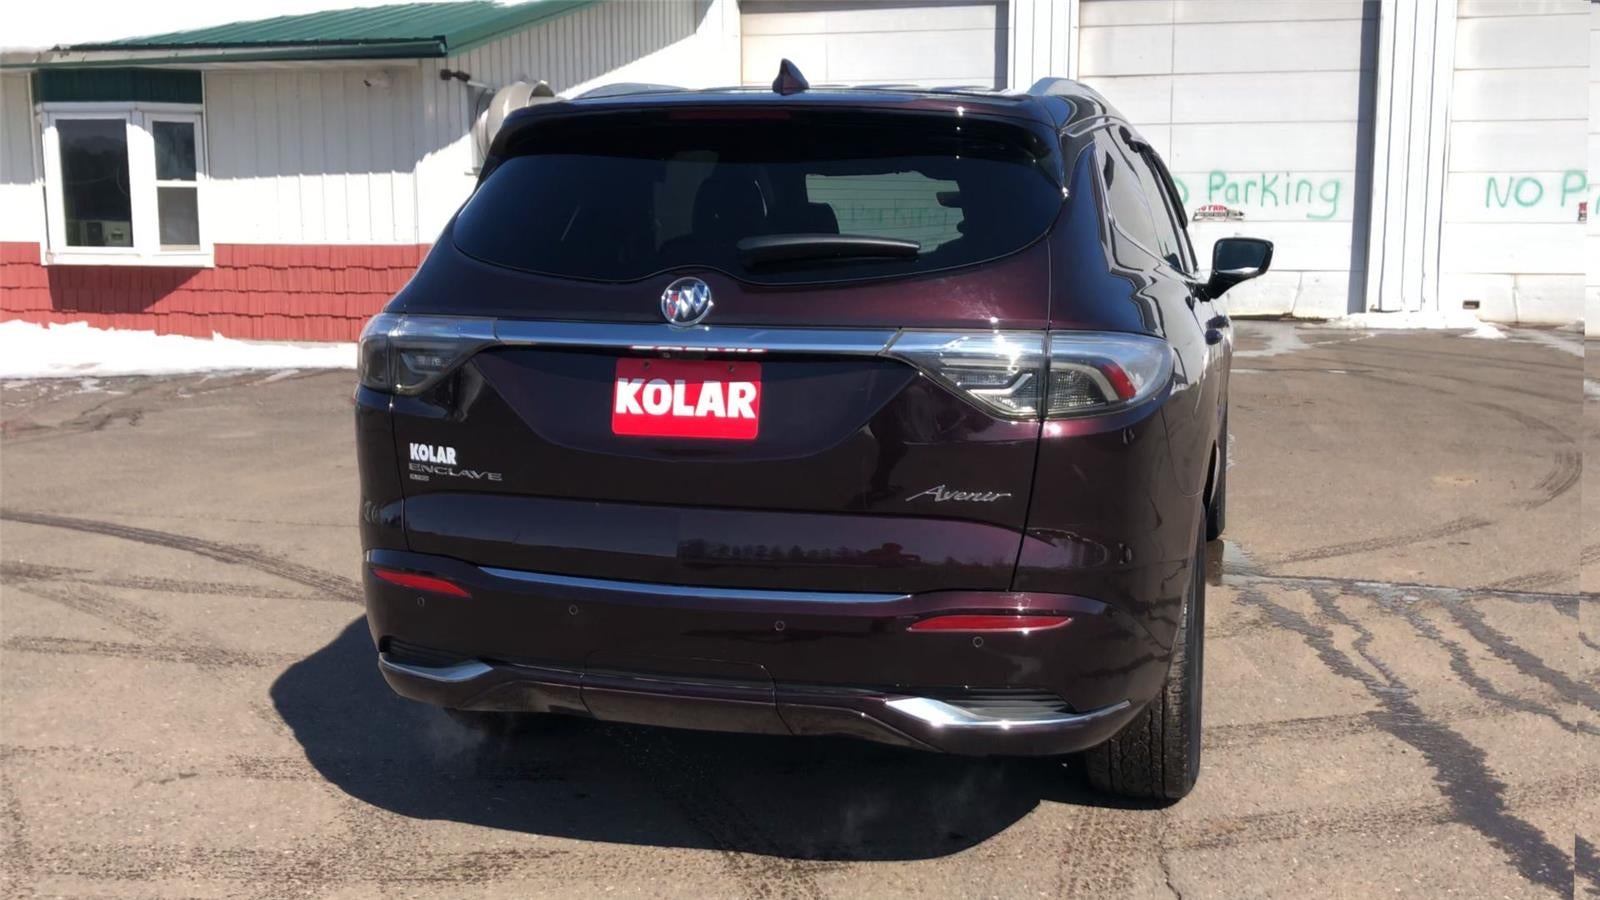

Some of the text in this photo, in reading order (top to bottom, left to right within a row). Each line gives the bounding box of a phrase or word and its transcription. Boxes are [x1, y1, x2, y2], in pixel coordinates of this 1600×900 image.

[1485, 176, 1544, 208] NO
[615, 377, 757, 419] KOLAR
[409, 442, 457, 465] KOLAR
[408, 462, 503, 481] ENCLAVE
[905, 484, 1012, 502] Avenir
